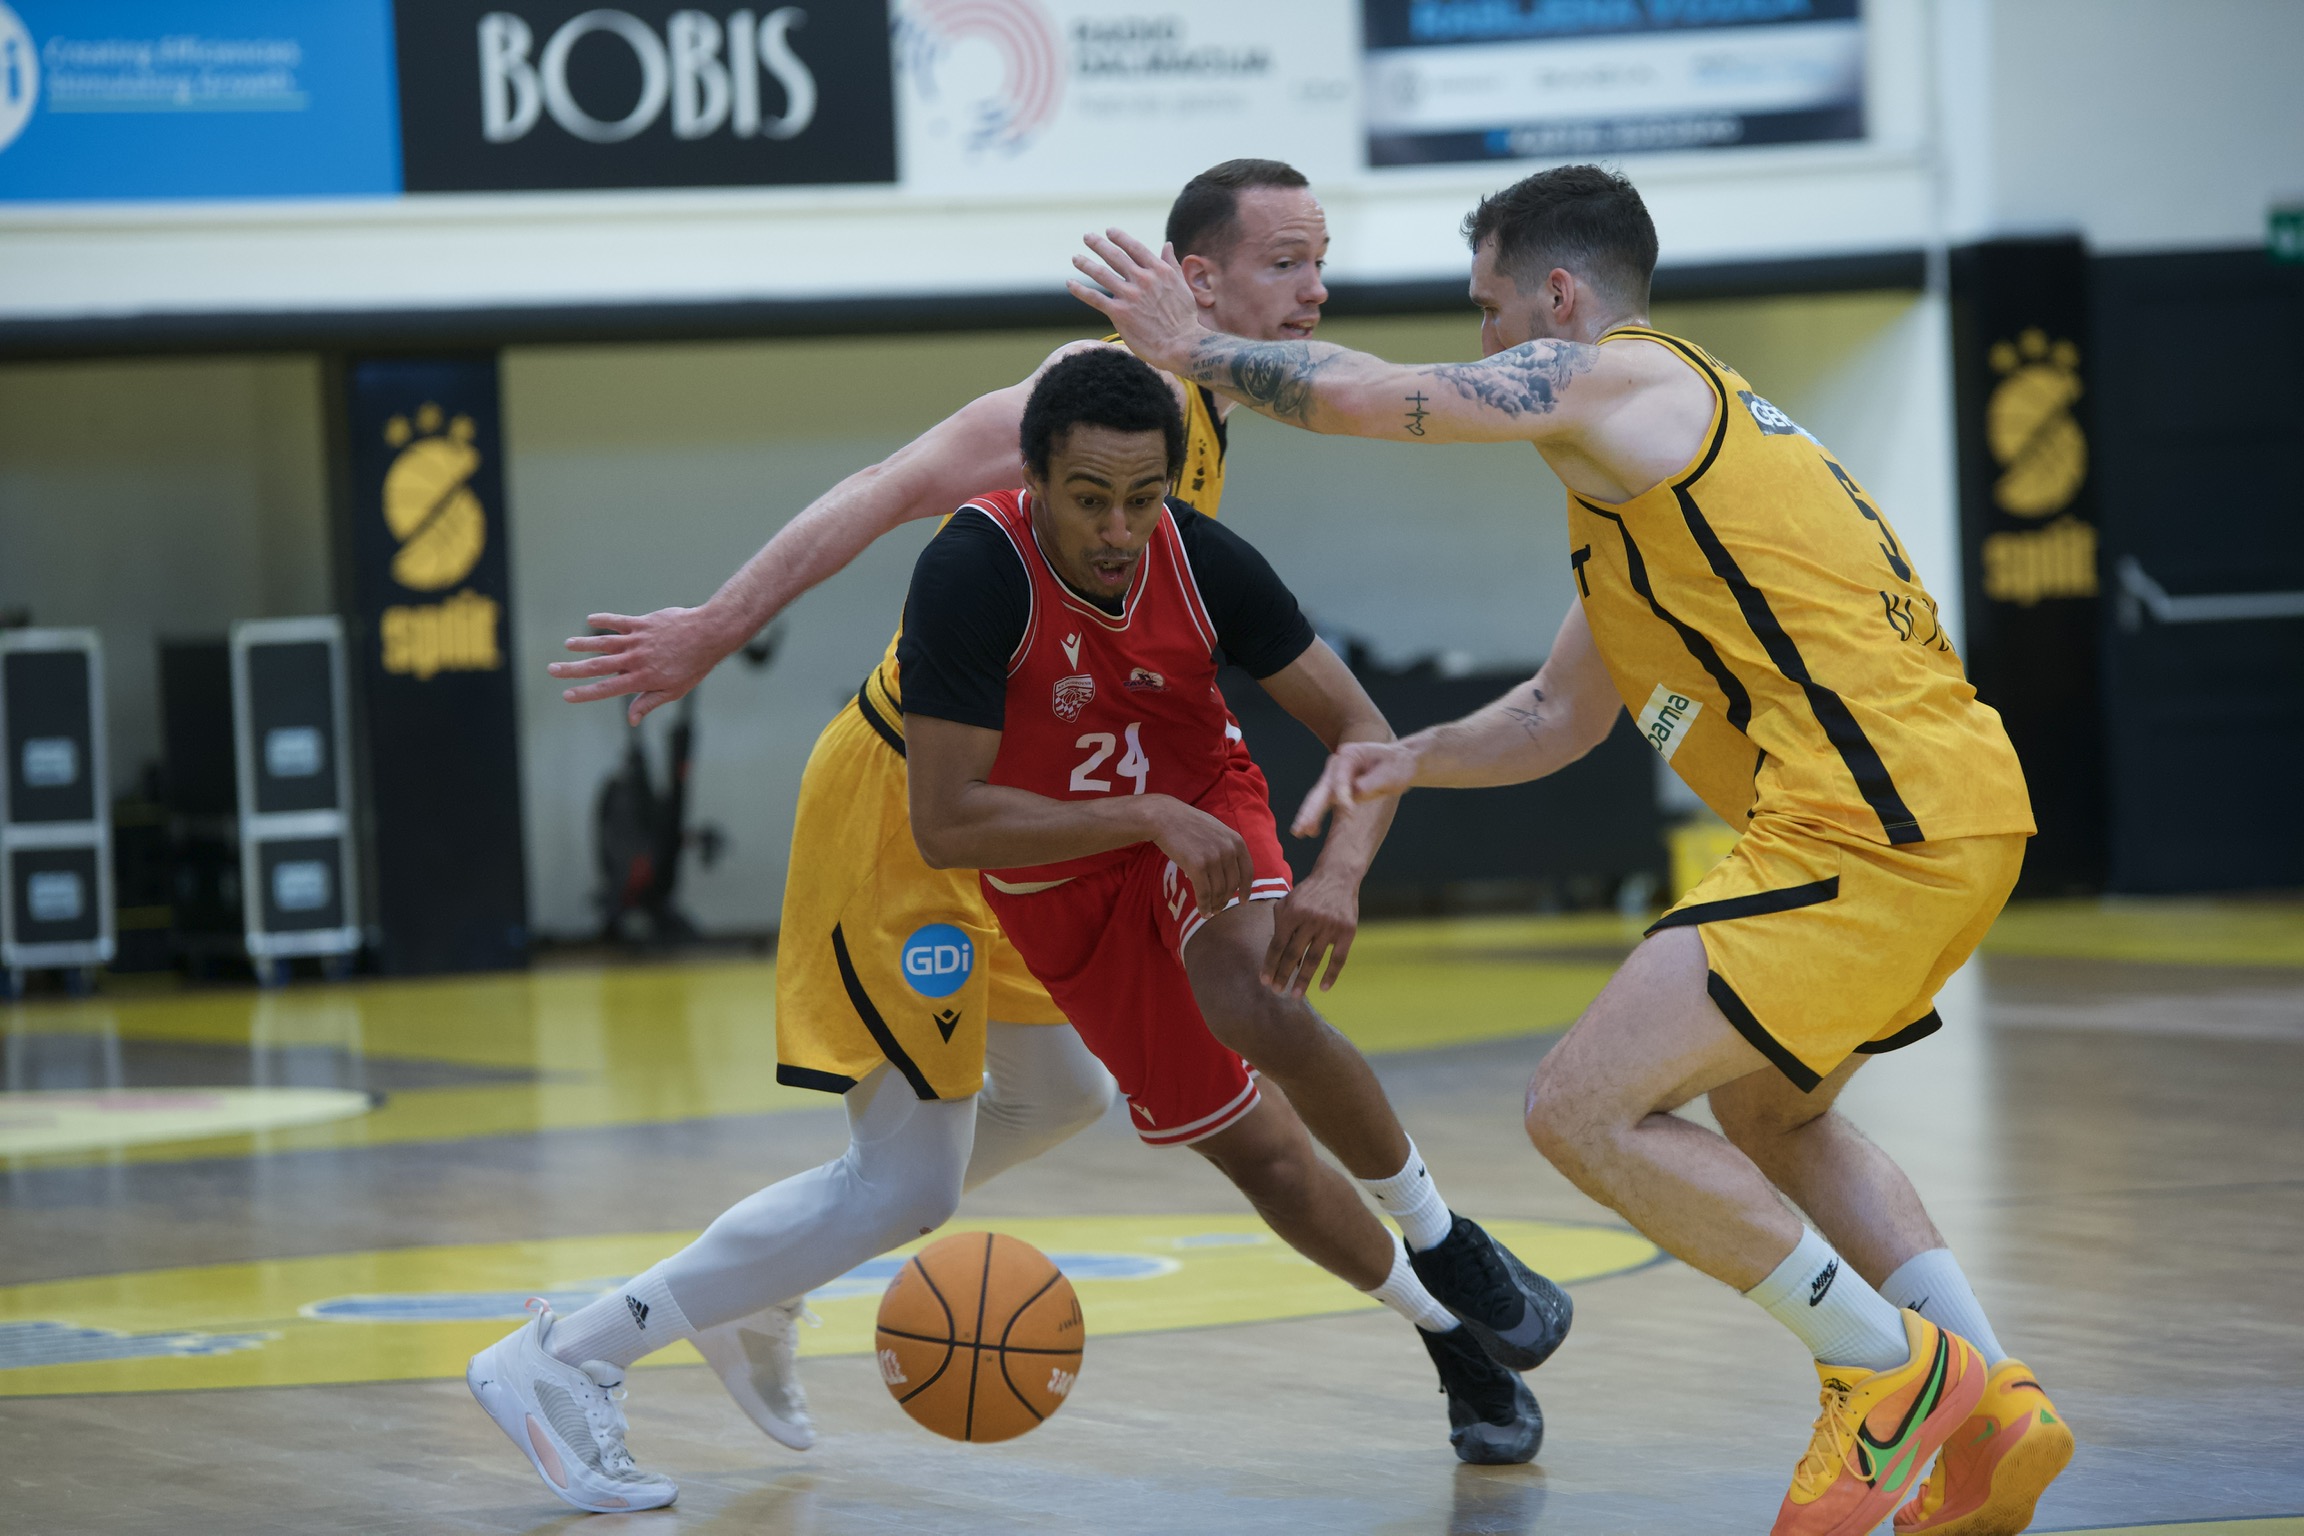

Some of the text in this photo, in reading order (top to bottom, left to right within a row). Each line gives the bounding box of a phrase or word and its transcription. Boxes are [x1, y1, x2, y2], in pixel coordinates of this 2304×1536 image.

[477, 7, 817, 143] BOBIS
[1069, 721, 1150, 796] 24
[905, 942, 970, 976] GDi
[1811, 1259, 1834, 1295] NIKE
[625, 1294, 646, 1331] adidas
